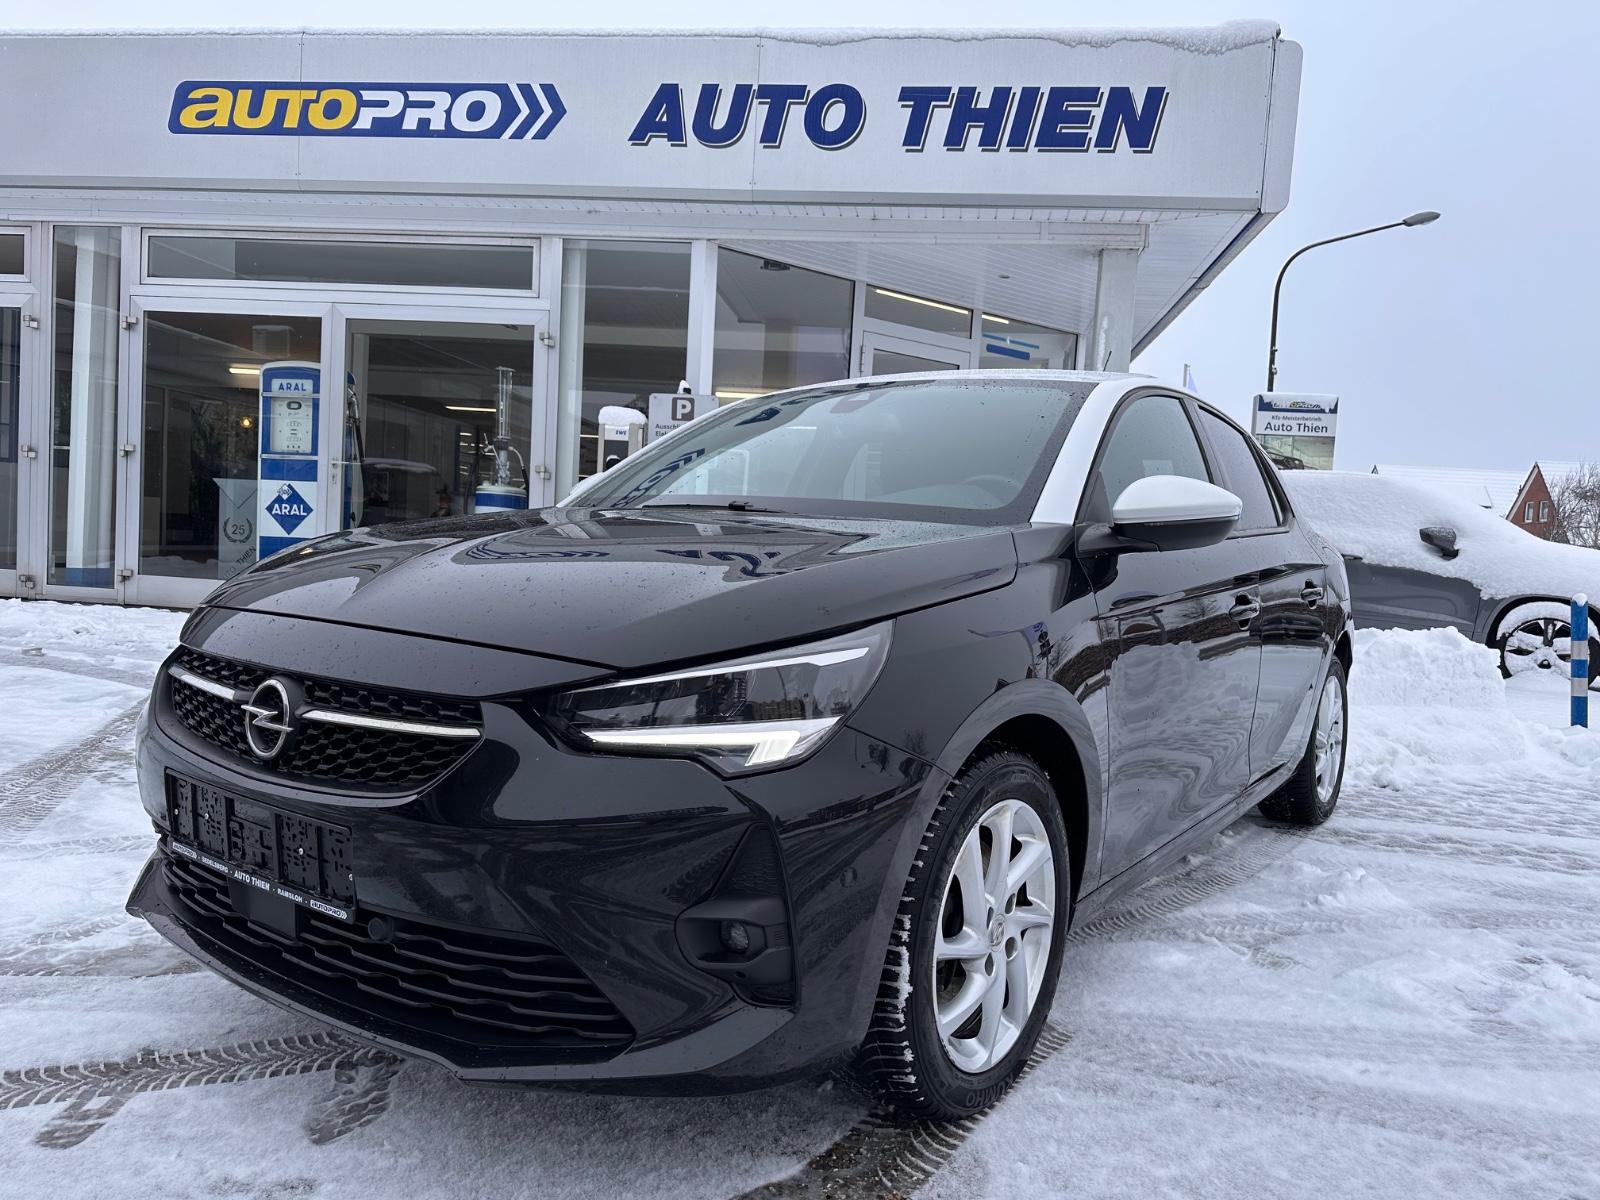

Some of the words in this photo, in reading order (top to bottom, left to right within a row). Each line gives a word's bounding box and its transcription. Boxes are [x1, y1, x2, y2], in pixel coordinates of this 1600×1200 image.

[627, 83, 866, 151] AUTO
[898, 86, 1168, 154] THIEN
[278, 382, 307, 392] ARAL
[676, 400, 691, 419] P
[1264, 422, 1293, 432] Auto
[1296, 422, 1328, 433] Thien
[271, 503, 307, 516] ARAL
[231, 523, 246, 536] 25
[233, 870, 250, 883] AUTO
[251, 876, 270, 891] THIEN
